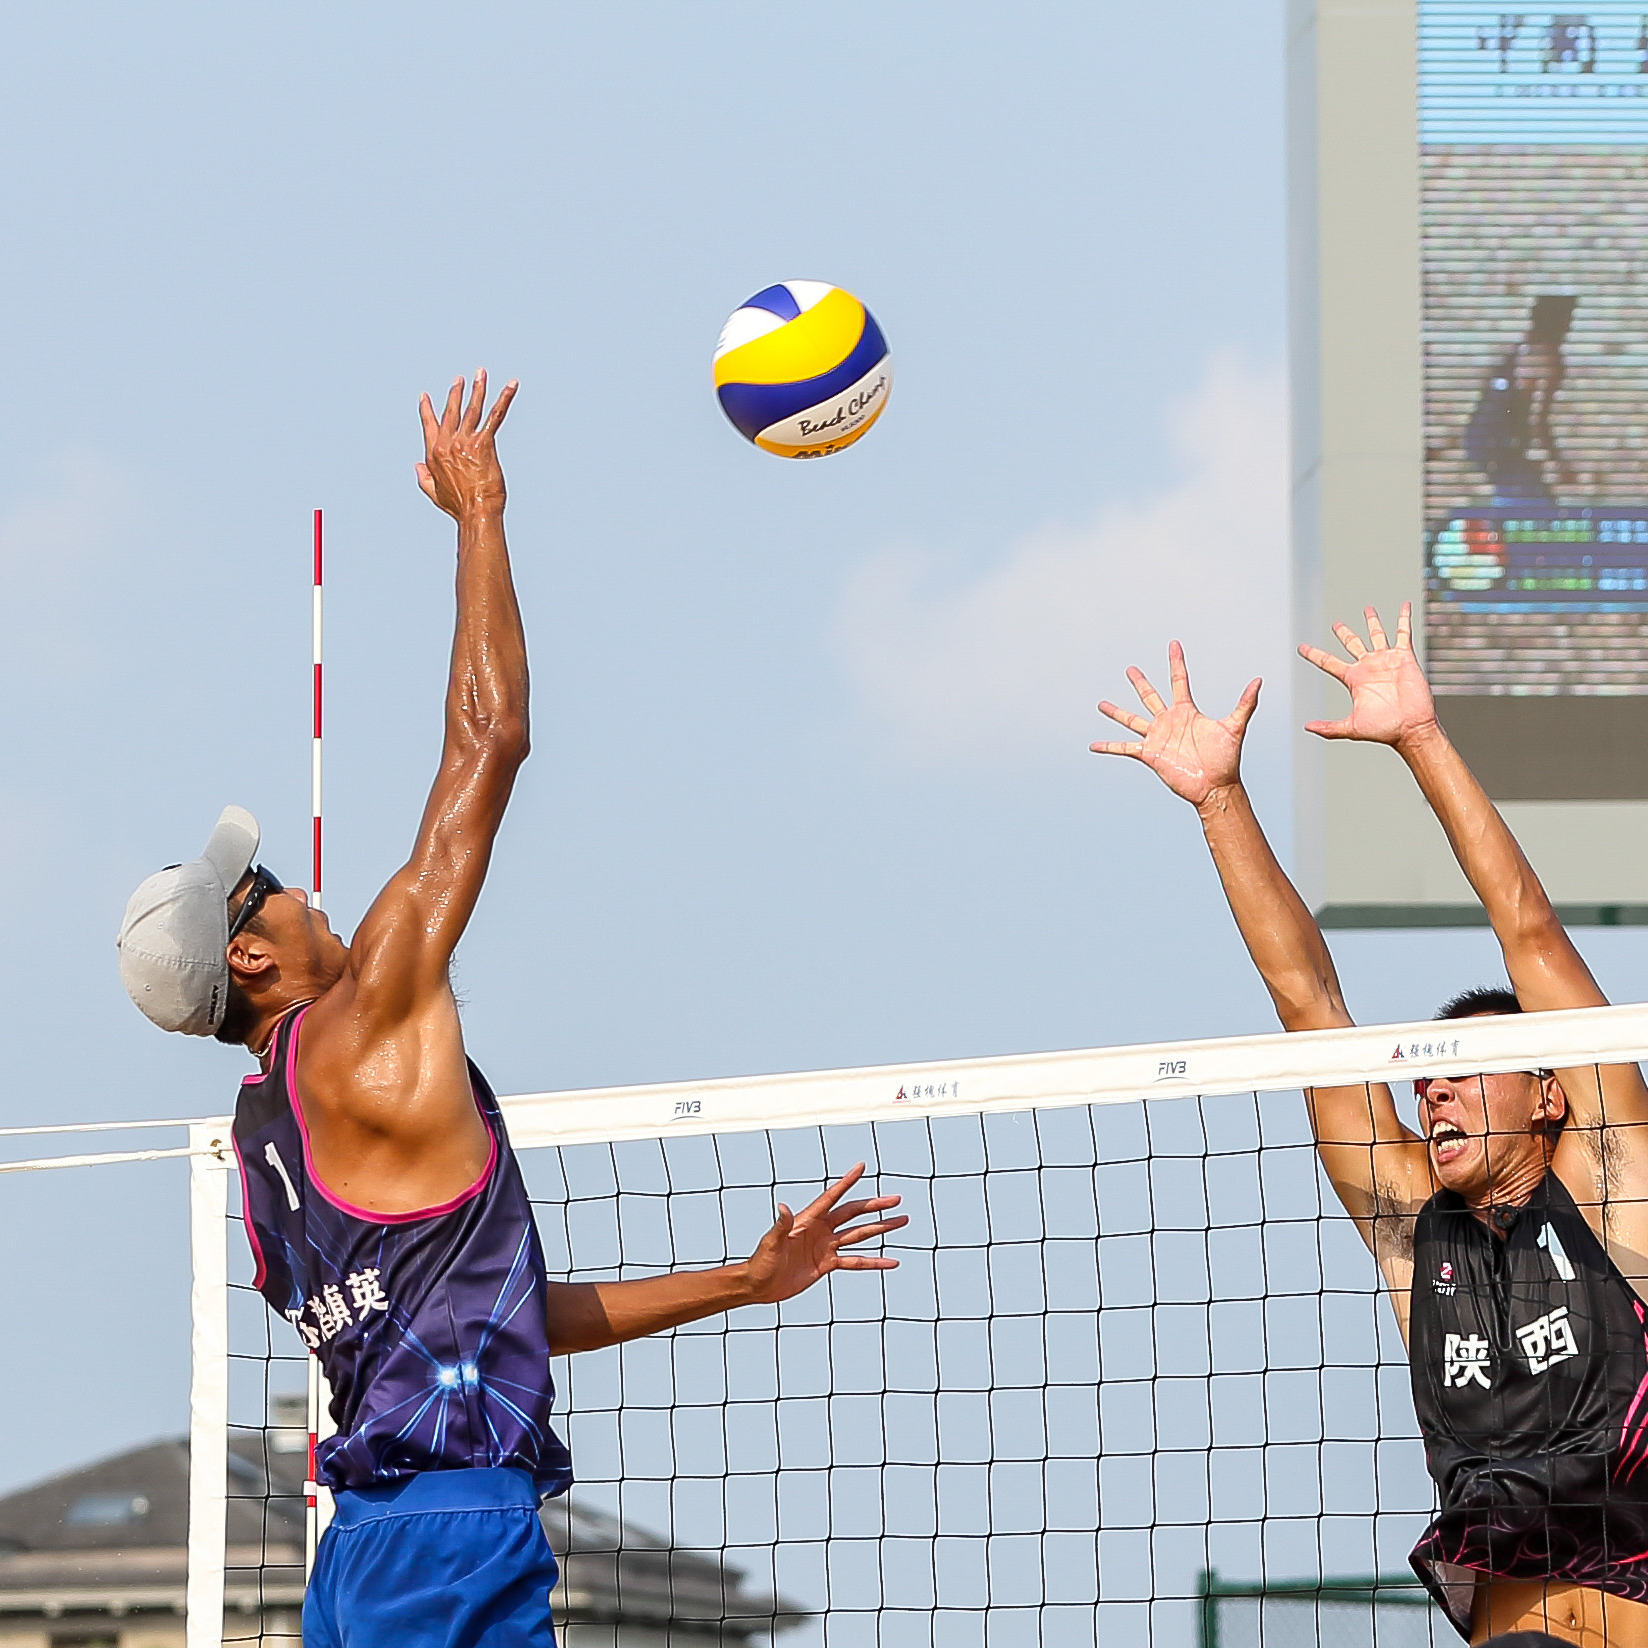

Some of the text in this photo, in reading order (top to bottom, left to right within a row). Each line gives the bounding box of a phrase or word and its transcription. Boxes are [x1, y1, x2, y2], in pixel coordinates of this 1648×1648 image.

[1158, 1061, 1187, 1075] FIVB
[674, 1101, 702, 1114] FIVB
[264, 1141, 300, 1212] 1
[1537, 1221, 1576, 1282] 1
[1444, 1306, 1579, 1390] 陕西
